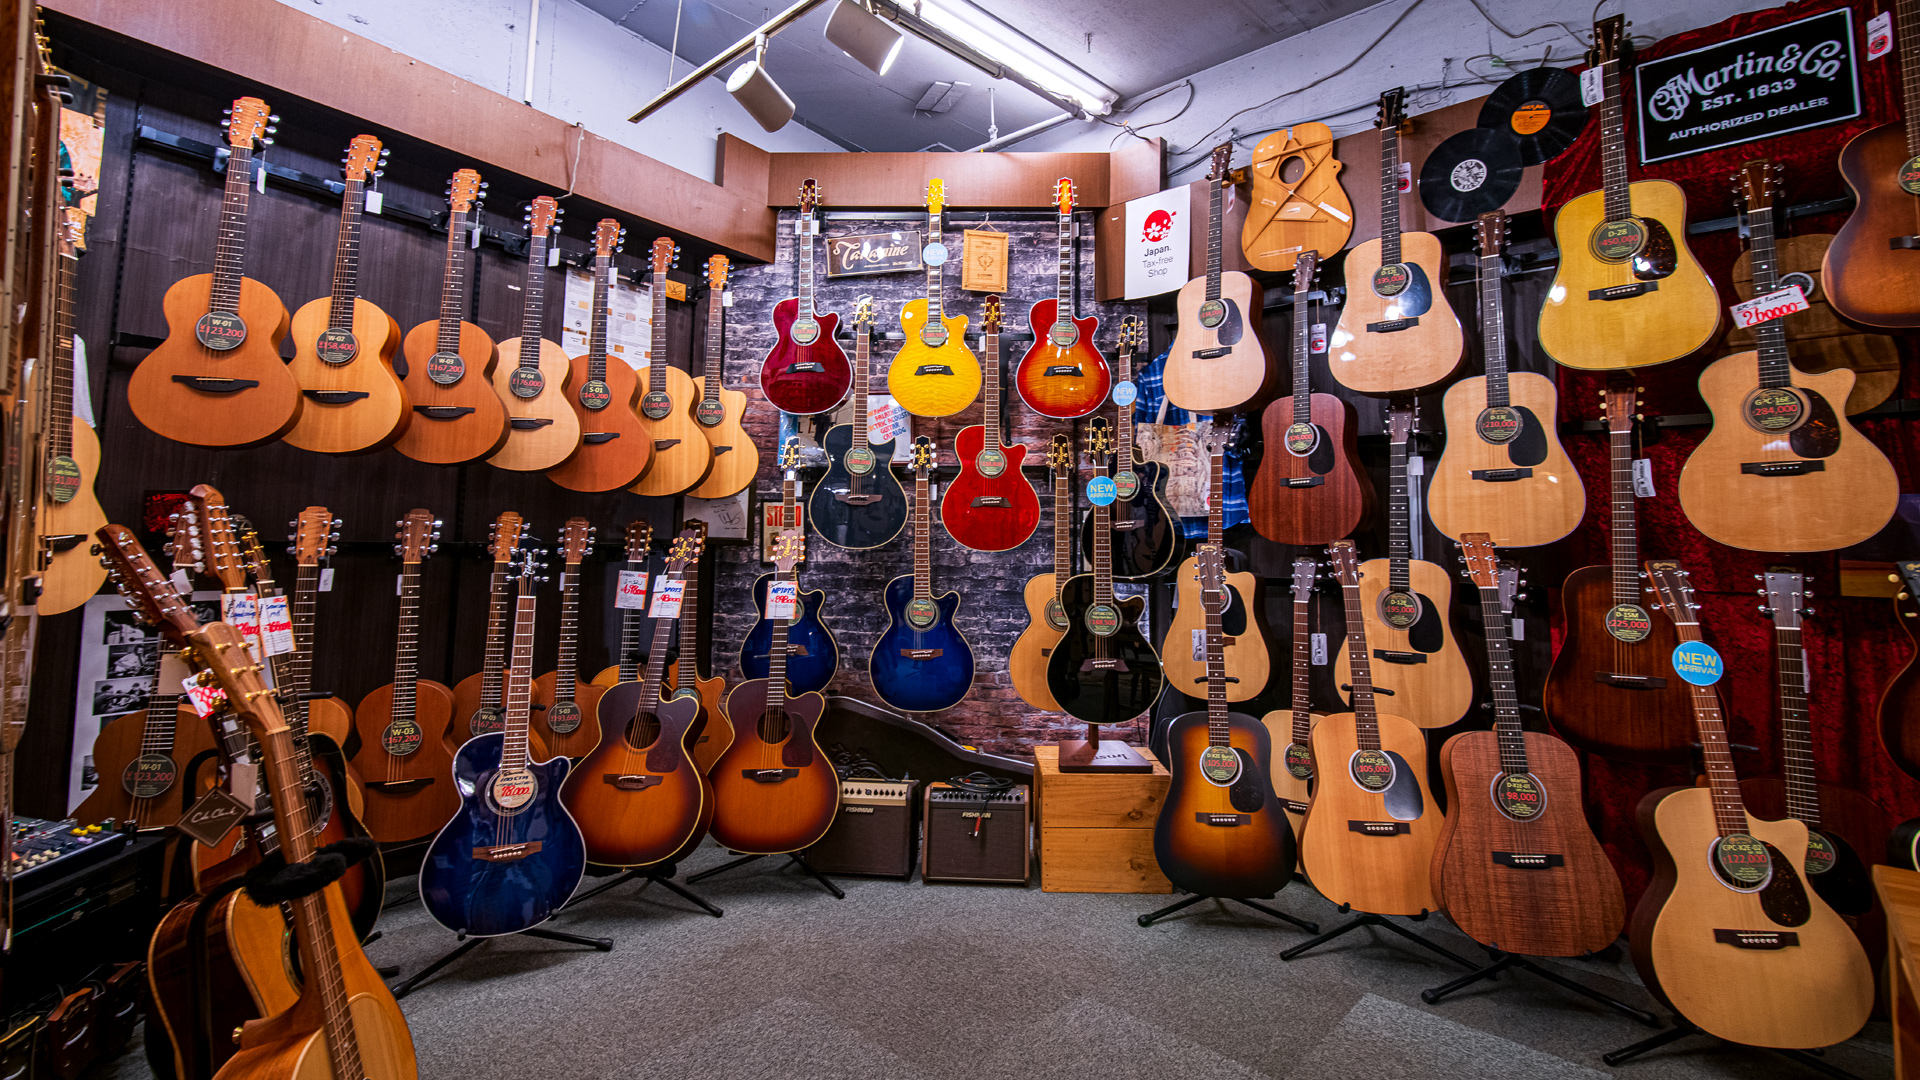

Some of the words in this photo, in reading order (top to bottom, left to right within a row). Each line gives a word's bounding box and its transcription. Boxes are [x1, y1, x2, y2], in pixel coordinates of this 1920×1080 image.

[1701, 93, 1742, 111] EST.
[1747, 78, 1797, 99] 1833
[1668, 112, 1765, 141] AUTHORIZED
[1767, 97, 1829, 118] DEALER
[1608, 229, 1627, 237] D-28
[833, 241, 909, 270] Taaine
[1144, 245, 1171, 256] Japan.
[1142, 256, 1174, 268] Tax-free
[1148, 267, 1168, 278] Shop
[199, 324, 244, 337] ¥123,200
[318, 340, 354, 350] ¥158,400
[430, 364, 462, 373] ¥167,200
[880, 422, 900, 434] GUITAR
[883, 427, 906, 440] CATALOG
[1090, 484, 1114, 492] NEW
[766, 506, 801, 526] STEO
[1386, 606, 1415, 614] ¥195,000
[1608, 620, 1648, 629] ¥225,000
[1678, 651, 1717, 667] NEW
[1678, 664, 1719, 676] ARRIVAL
[392, 728, 414, 736] W-03
[384, 735, 419, 744] ¥167,200
[1205, 760, 1235, 768] ¥105,000
[126, 771, 173, 780] ¥123,200
[1507, 792, 1537, 801] 98,000
[1723, 854, 1767, 864] ¥122,000
